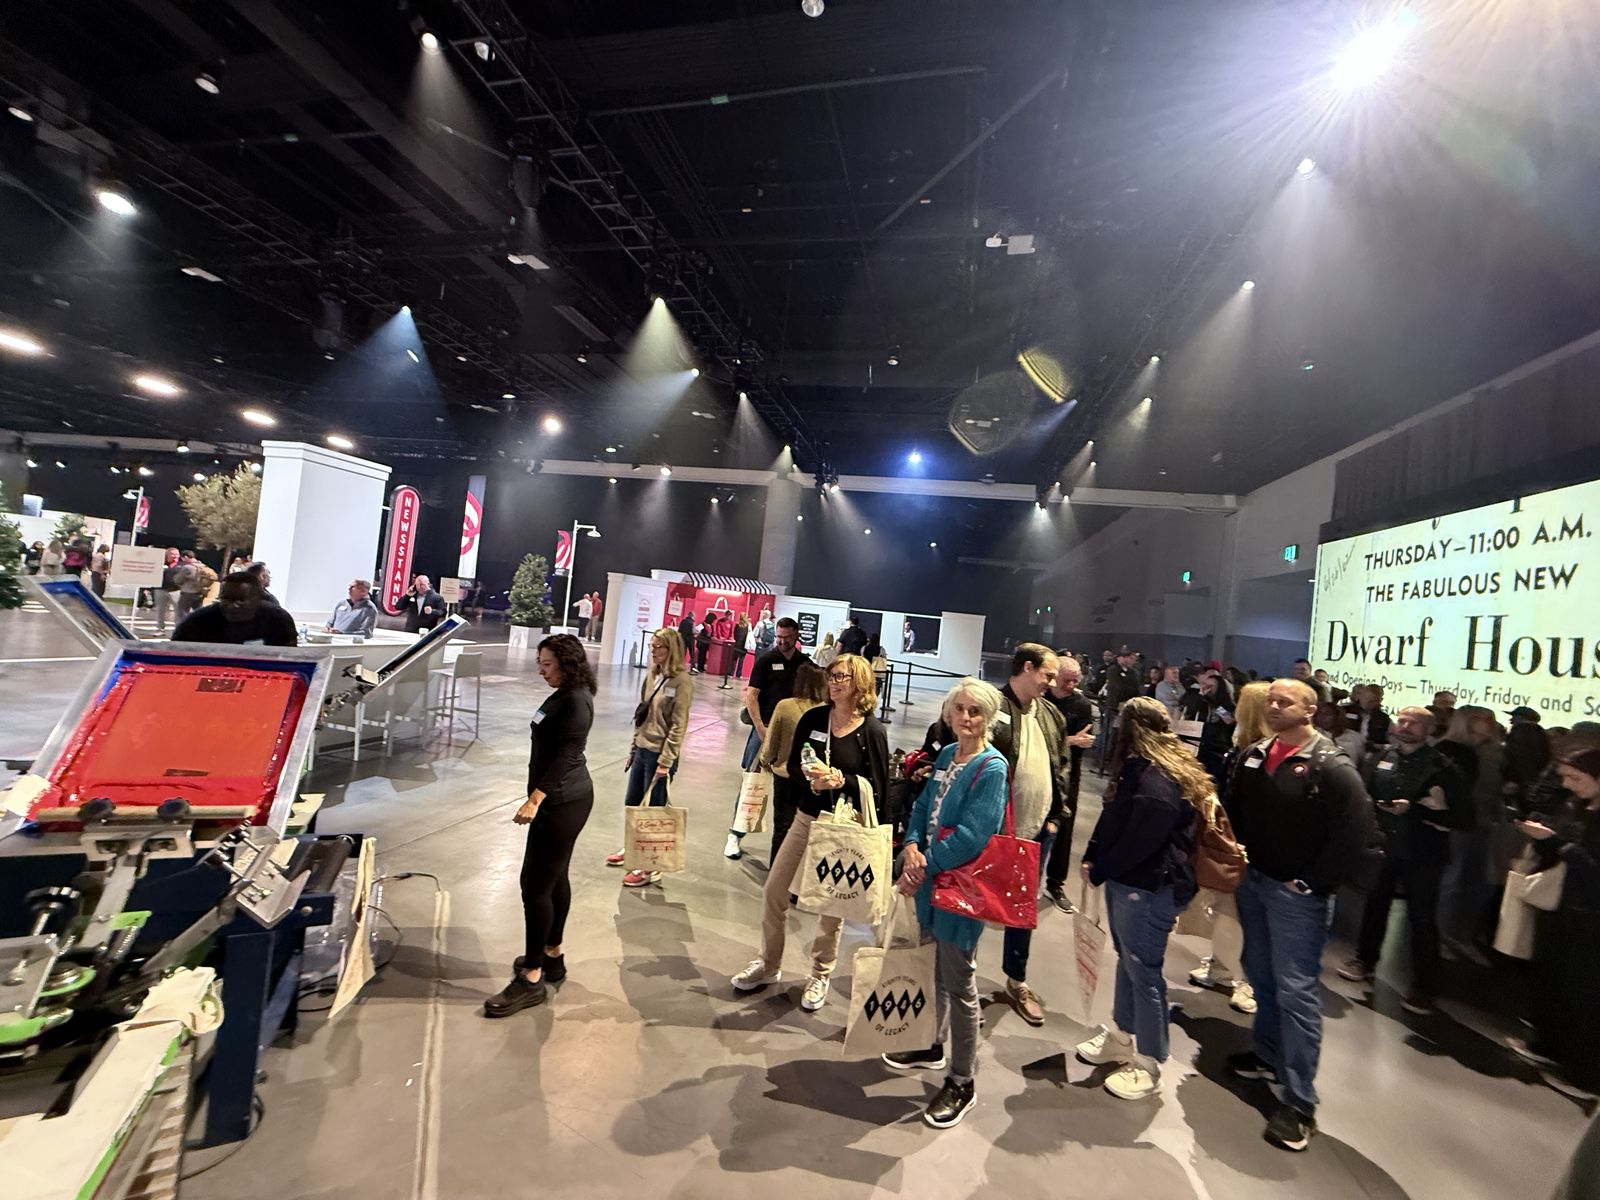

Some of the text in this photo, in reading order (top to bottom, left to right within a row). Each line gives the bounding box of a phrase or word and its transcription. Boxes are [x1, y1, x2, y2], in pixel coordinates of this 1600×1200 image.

[1531, 512, 1592, 546] A.M.
[391, 497, 412, 606] NEWSSTAND
[1366, 562, 1579, 603] THE FABULOUS NEW
[1324, 616, 1434, 667] Dwarf
[1381, 675, 1403, 694] Days
[1420, 679, 1479, 704] Thday,
[1540, 693, 1573, 713] and
